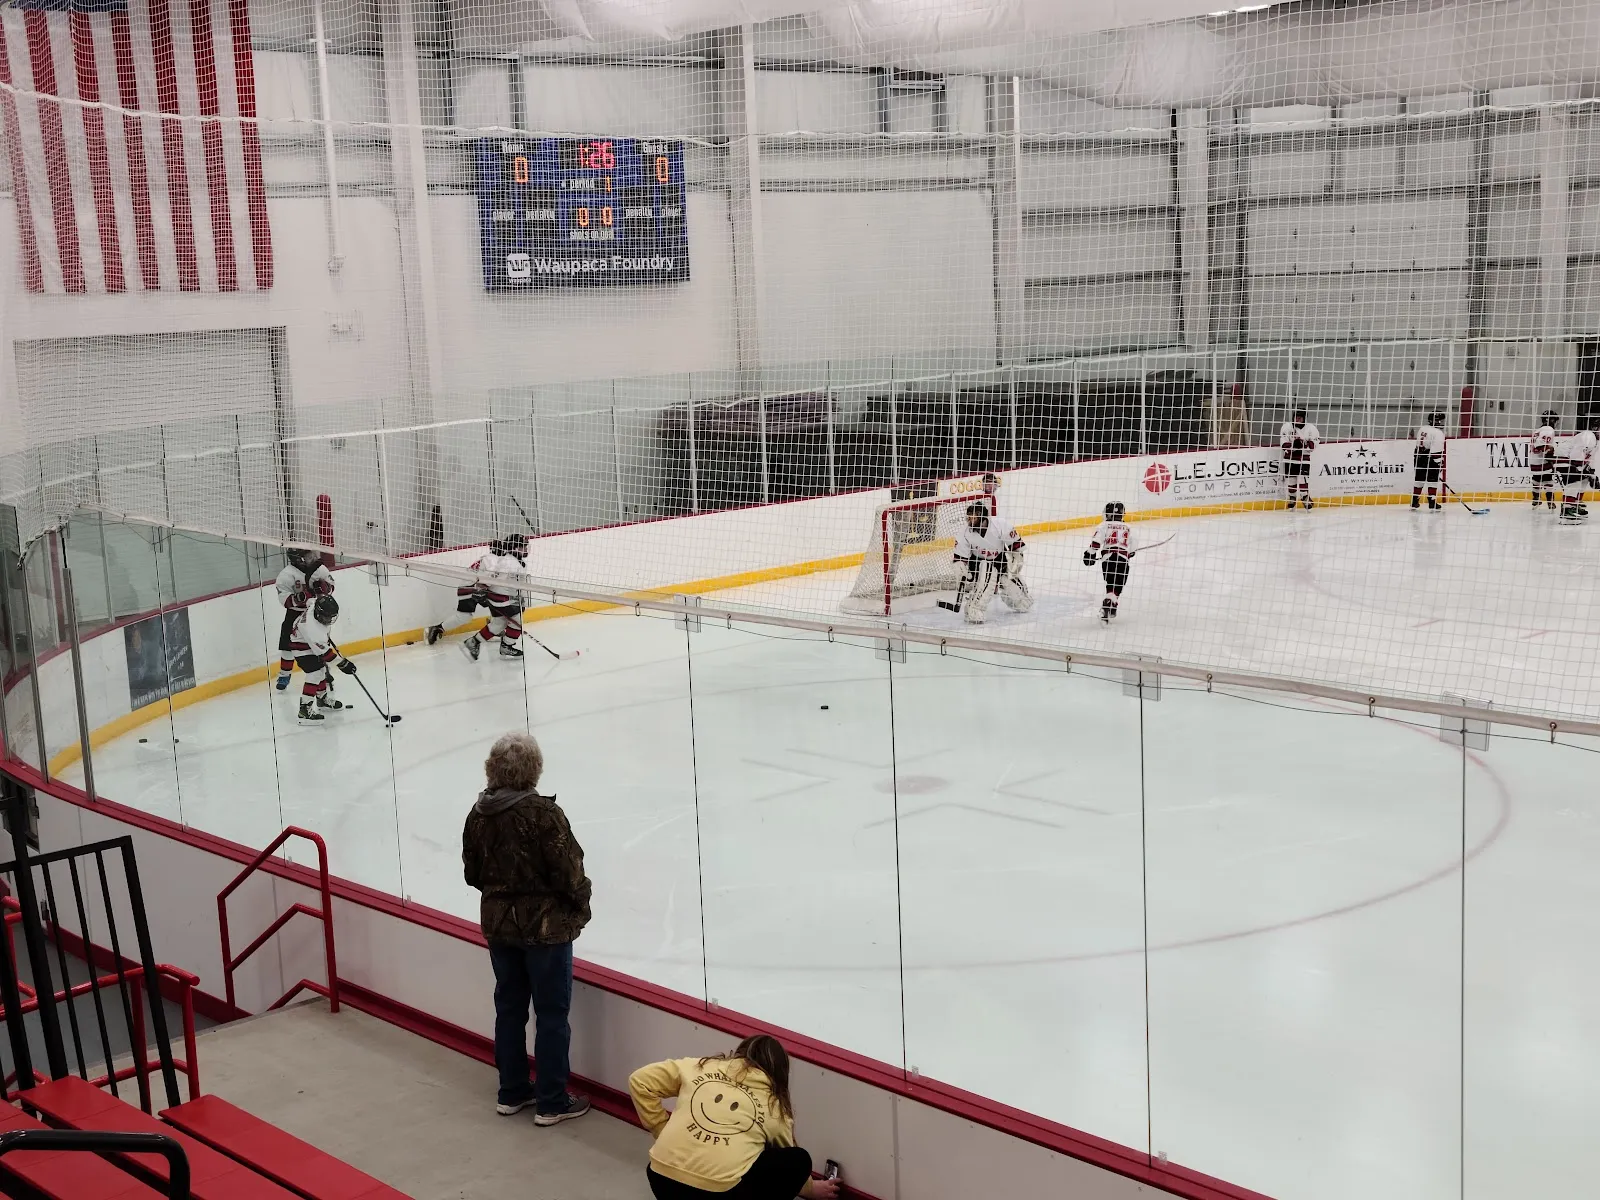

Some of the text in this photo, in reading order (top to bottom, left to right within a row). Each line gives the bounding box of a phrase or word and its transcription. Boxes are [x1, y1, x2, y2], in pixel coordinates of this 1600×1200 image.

[642, 141, 668, 153] Guests
[514, 156, 528, 183] 0
[656, 156, 669, 183] 0
[570, 179, 595, 190] period
[578, 207, 590, 226] 0
[602, 206, 614, 226] 0
[625, 207, 653, 219] penalty
[534, 253, 675, 276] Waupaca Foundry
[1173, 460, 1280, 481] L.E. JONES
[692, 1075, 705, 1086] DO
[686, 1122, 731, 1146] HAPPY
